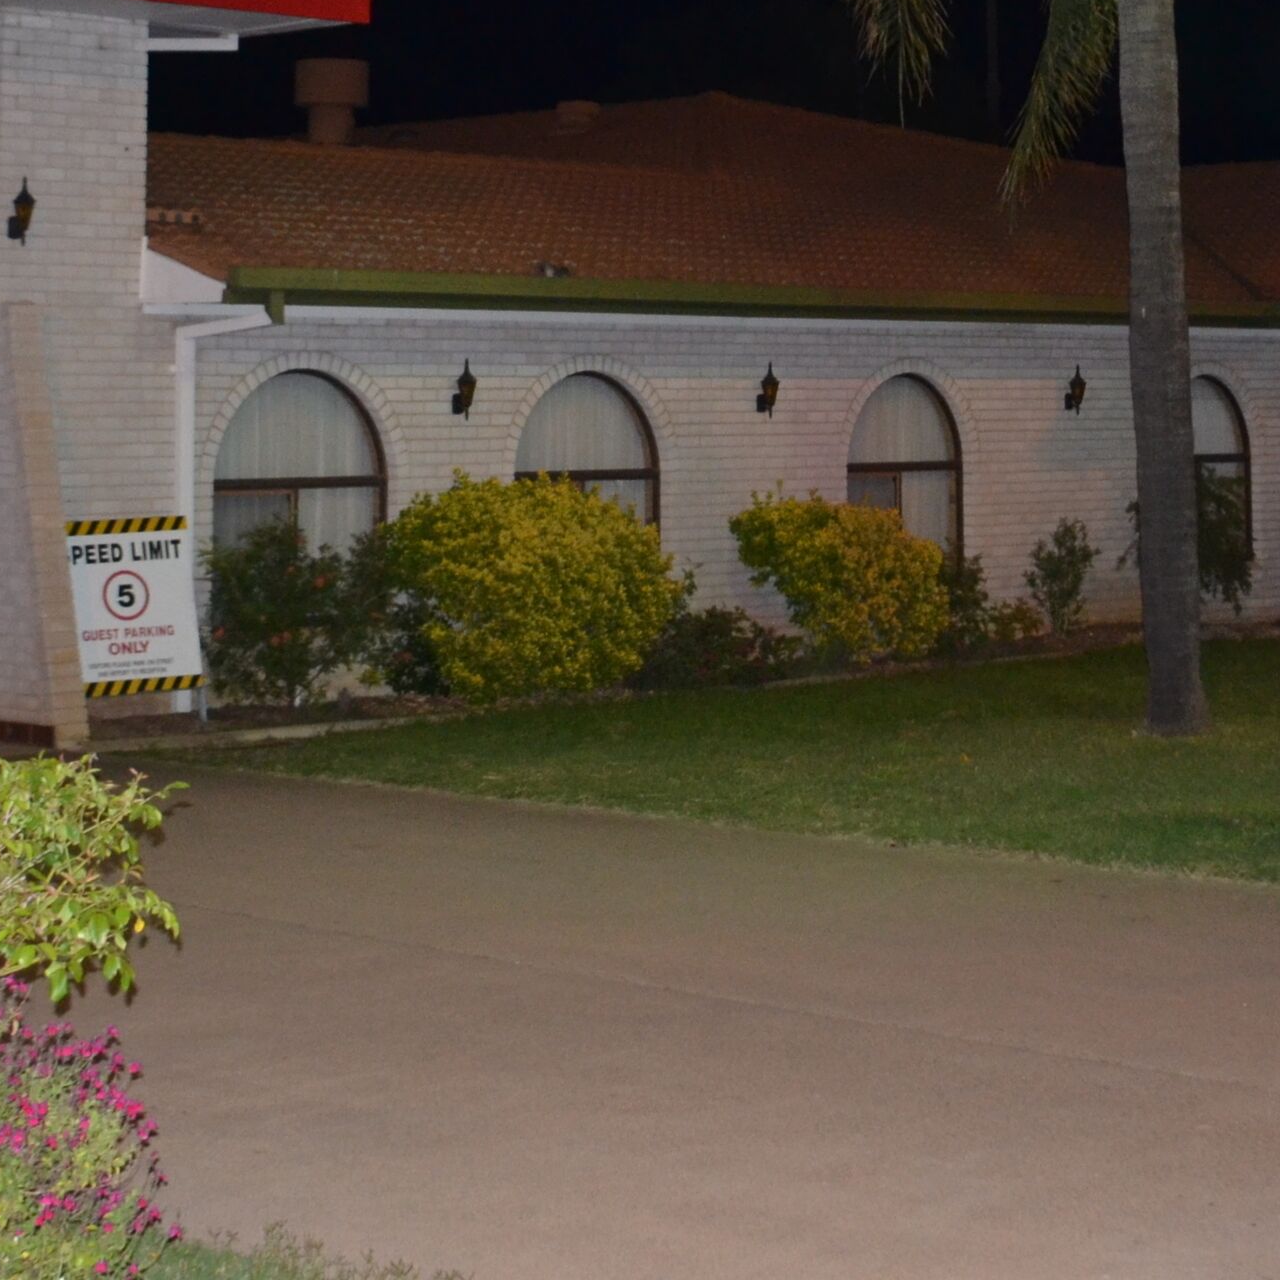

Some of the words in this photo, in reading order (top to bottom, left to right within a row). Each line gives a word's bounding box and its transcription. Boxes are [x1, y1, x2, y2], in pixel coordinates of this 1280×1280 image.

[68, 543, 123, 565] PEED
[131, 539, 182, 562] LIMIT
[117, 584, 136, 608] 5
[82, 628, 119, 642] GUEST
[124, 624, 176, 639] PARKING
[108, 640, 150, 655] ONLY
